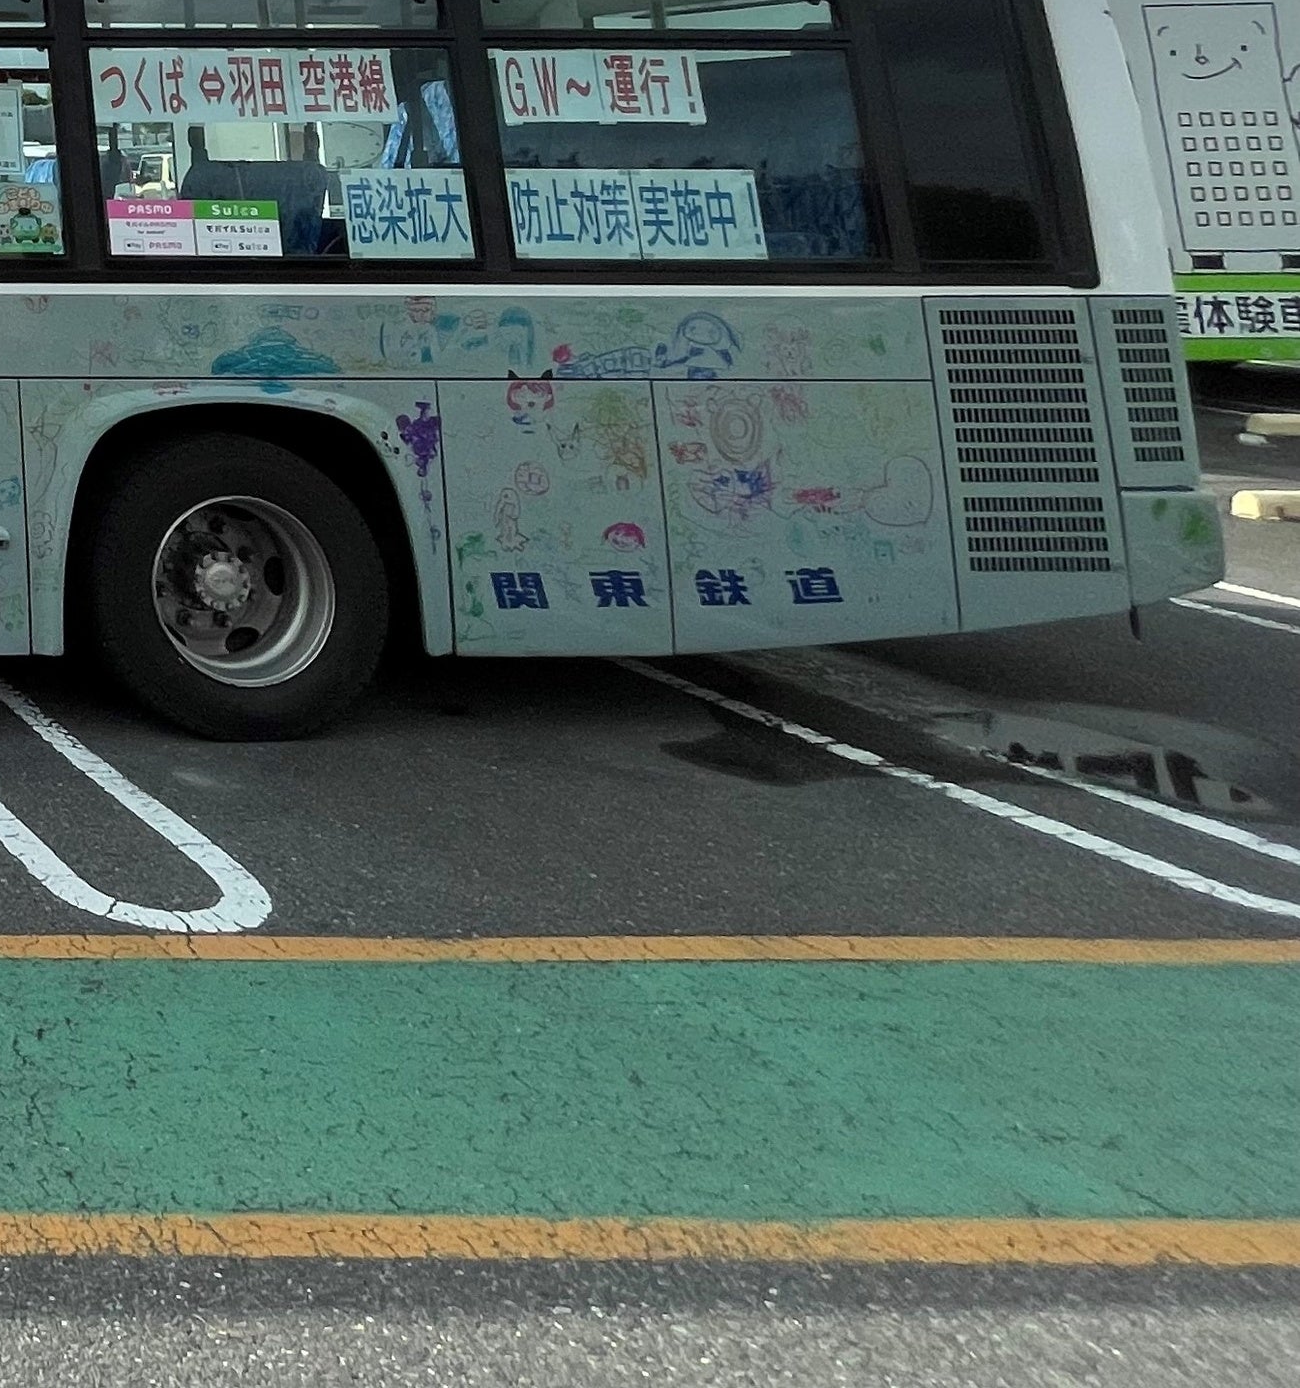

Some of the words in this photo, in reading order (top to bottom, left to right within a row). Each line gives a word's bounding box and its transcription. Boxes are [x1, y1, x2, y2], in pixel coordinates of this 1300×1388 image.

[128, 204, 172, 214] PASMO
[211, 204, 259, 216] Suica
[346, 177, 469, 245] 感染拡大
[489, 566, 845, 610] 関東鉄道
